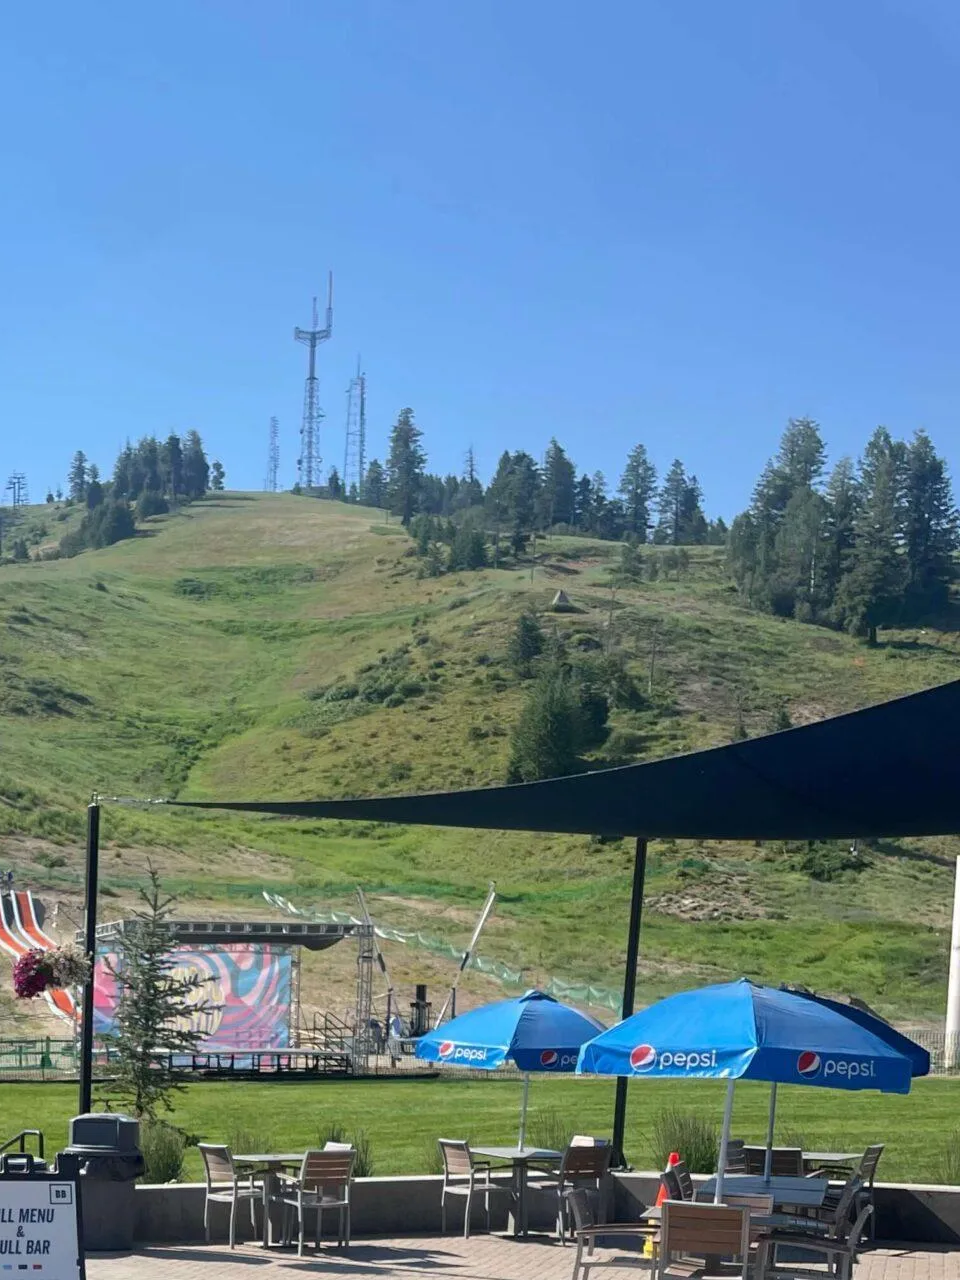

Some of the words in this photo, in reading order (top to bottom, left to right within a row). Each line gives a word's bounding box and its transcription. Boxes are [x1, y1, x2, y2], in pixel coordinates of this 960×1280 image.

[454, 1047, 487, 1061] pepsi
[659, 1049, 717, 1070] pepsi
[824, 1060, 876, 1079] pepsi
[18, 1208, 55, 1223] MENU
[16, 1225, 25, 1237] &
[26, 1240, 51, 1255] BAR
